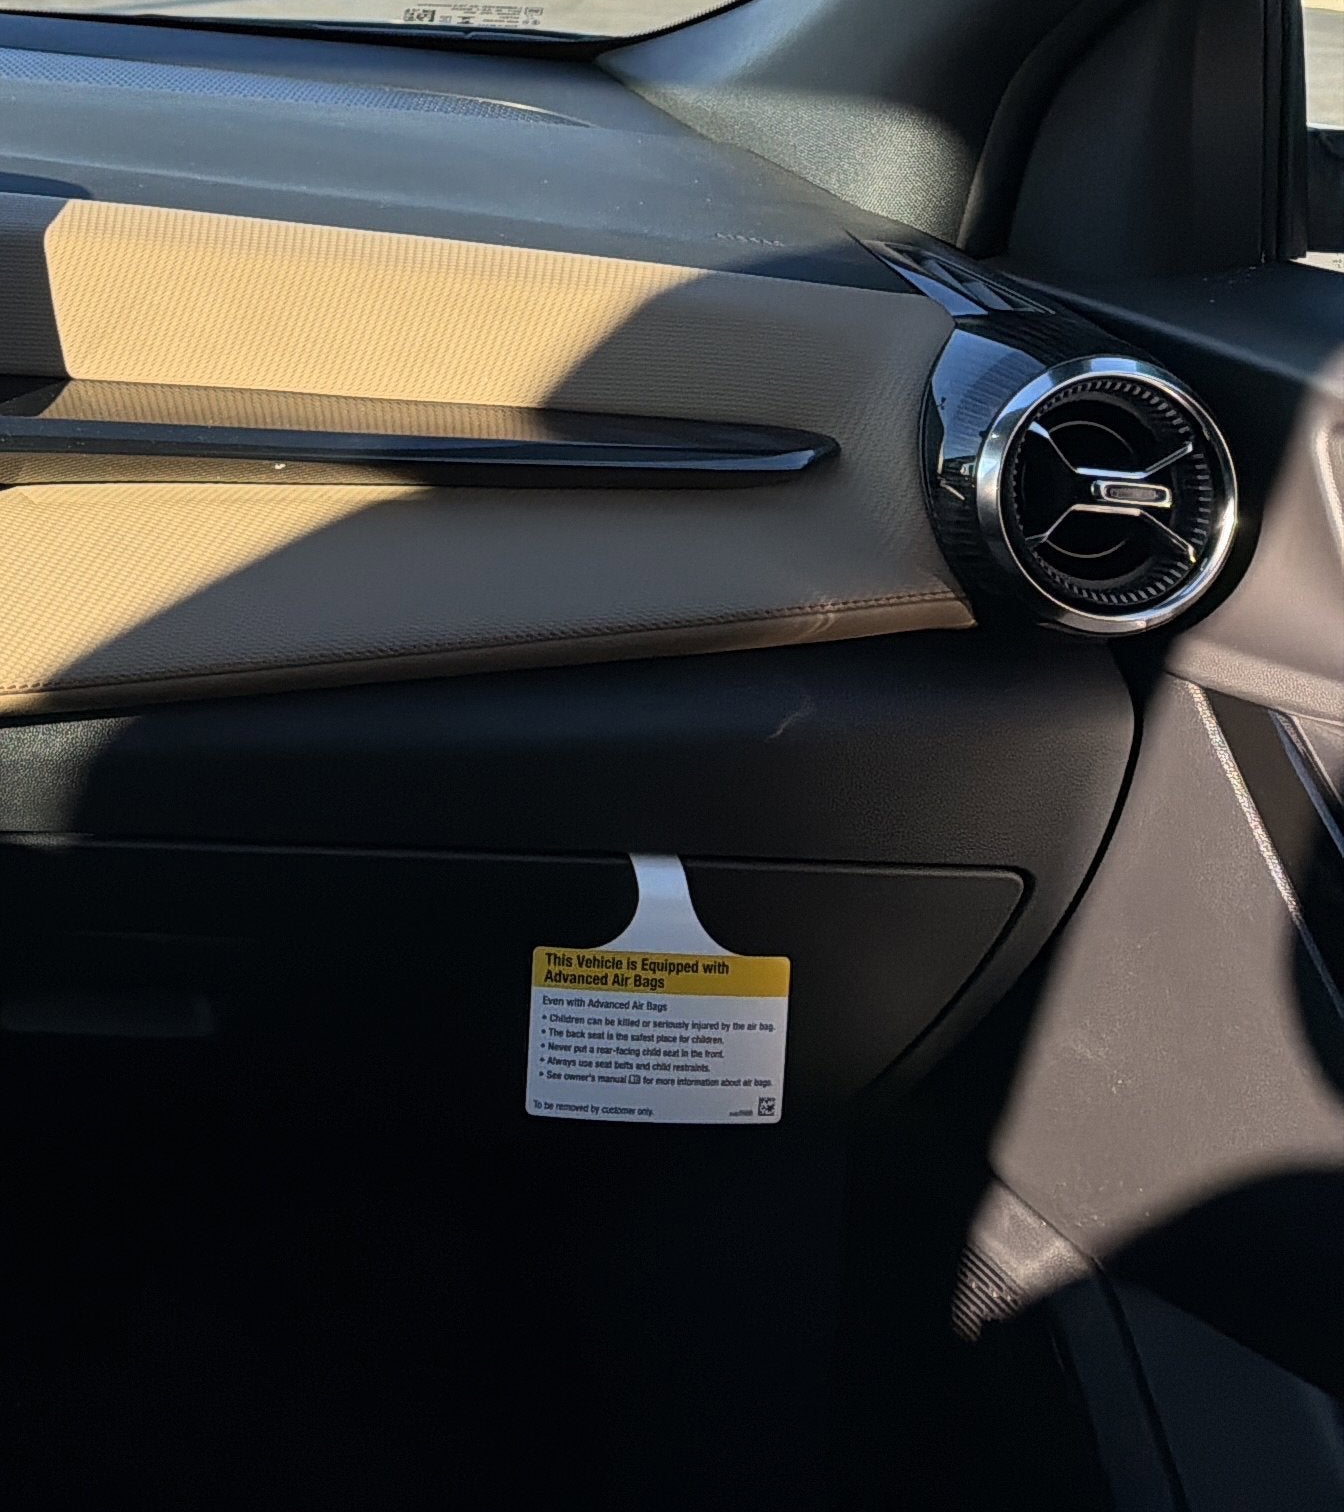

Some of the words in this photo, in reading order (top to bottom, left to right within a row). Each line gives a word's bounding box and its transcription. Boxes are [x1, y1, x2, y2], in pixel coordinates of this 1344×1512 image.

[545, 952, 573, 967] This
[577, 954, 623, 970] Vehicle
[626, 957, 637, 970] is
[641, 958, 699, 975] Equipped
[703, 961, 730, 975] with
[544, 969, 608, 985] Advanced
[612, 973, 631, 987] Air
[634, 974, 664, 991] Bags
[542, 995, 564, 1006] Even
[566, 997, 585, 1007] with
[588, 999, 630, 1010] Advanced
[632, 1001, 644, 1010] Air
[646, 1002, 668, 1013] Bags
[550, 1014, 585, 1025] Children
[587, 1017, 602, 1025] can
[605, 1017, 615, 1026] be
[617, 1018, 640, 1027] killed
[653, 1019, 689, 1030] seriously
[691, 1020, 719, 1031] injured
[732, 1022, 745, 1031] the
[747, 1023, 756, 1031] air
[549, 1028, 564, 1037] The
[566, 1029, 585, 1038] back
[588, 1031, 605, 1039] seat
[607, 1032, 614, 1040] is
[616, 1032, 628, 1041] the
[631, 1033, 654, 1042] safest
[656, 1035, 677, 1044] place
[679, 1035, 689, 1043] for
[548, 1042, 571, 1052] Never
[642, 1047, 661, 1056] child
[547, 1056, 576, 1068] Always
[546, 1070, 562, 1079] See
[643, 1076, 654, 1085] for
